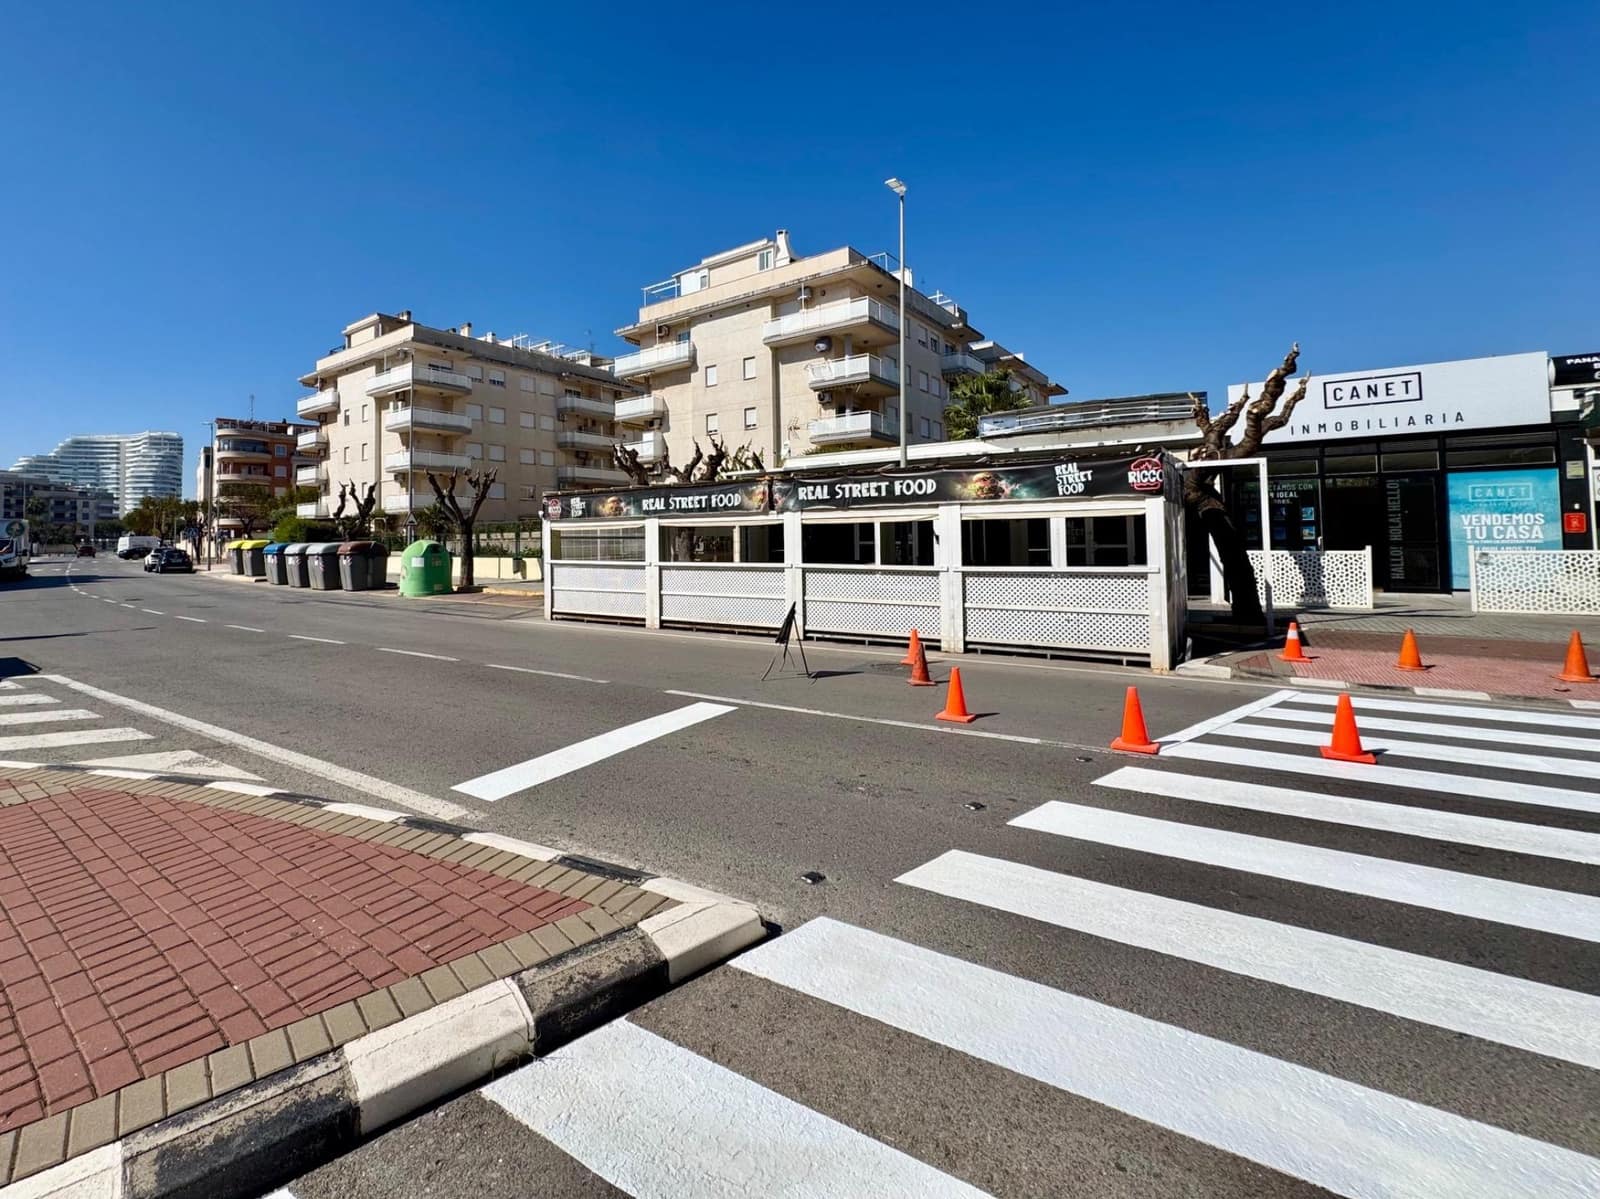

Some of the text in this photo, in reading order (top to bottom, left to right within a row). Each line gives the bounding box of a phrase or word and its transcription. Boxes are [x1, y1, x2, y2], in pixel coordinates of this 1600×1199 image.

[1332, 380, 1413, 402] CANET
[1290, 411, 1465, 436] INMOBILIARIA
[1055, 462, 1079, 476] REAL
[1056, 470, 1093, 485] STREET
[798, 478, 937, 500] REAL STREET FOOD
[1058, 482, 1085, 496] FOOD
[1474, 486, 1527, 498] CANET
[642, 493, 742, 511] REAL STREET FOOD
[1461, 513, 1545, 526] VENDEMOS
[1386, 479, 1406, 580] HALLO! HOLA! HELLO!
[1463, 525, 1545, 540] TU CASA
